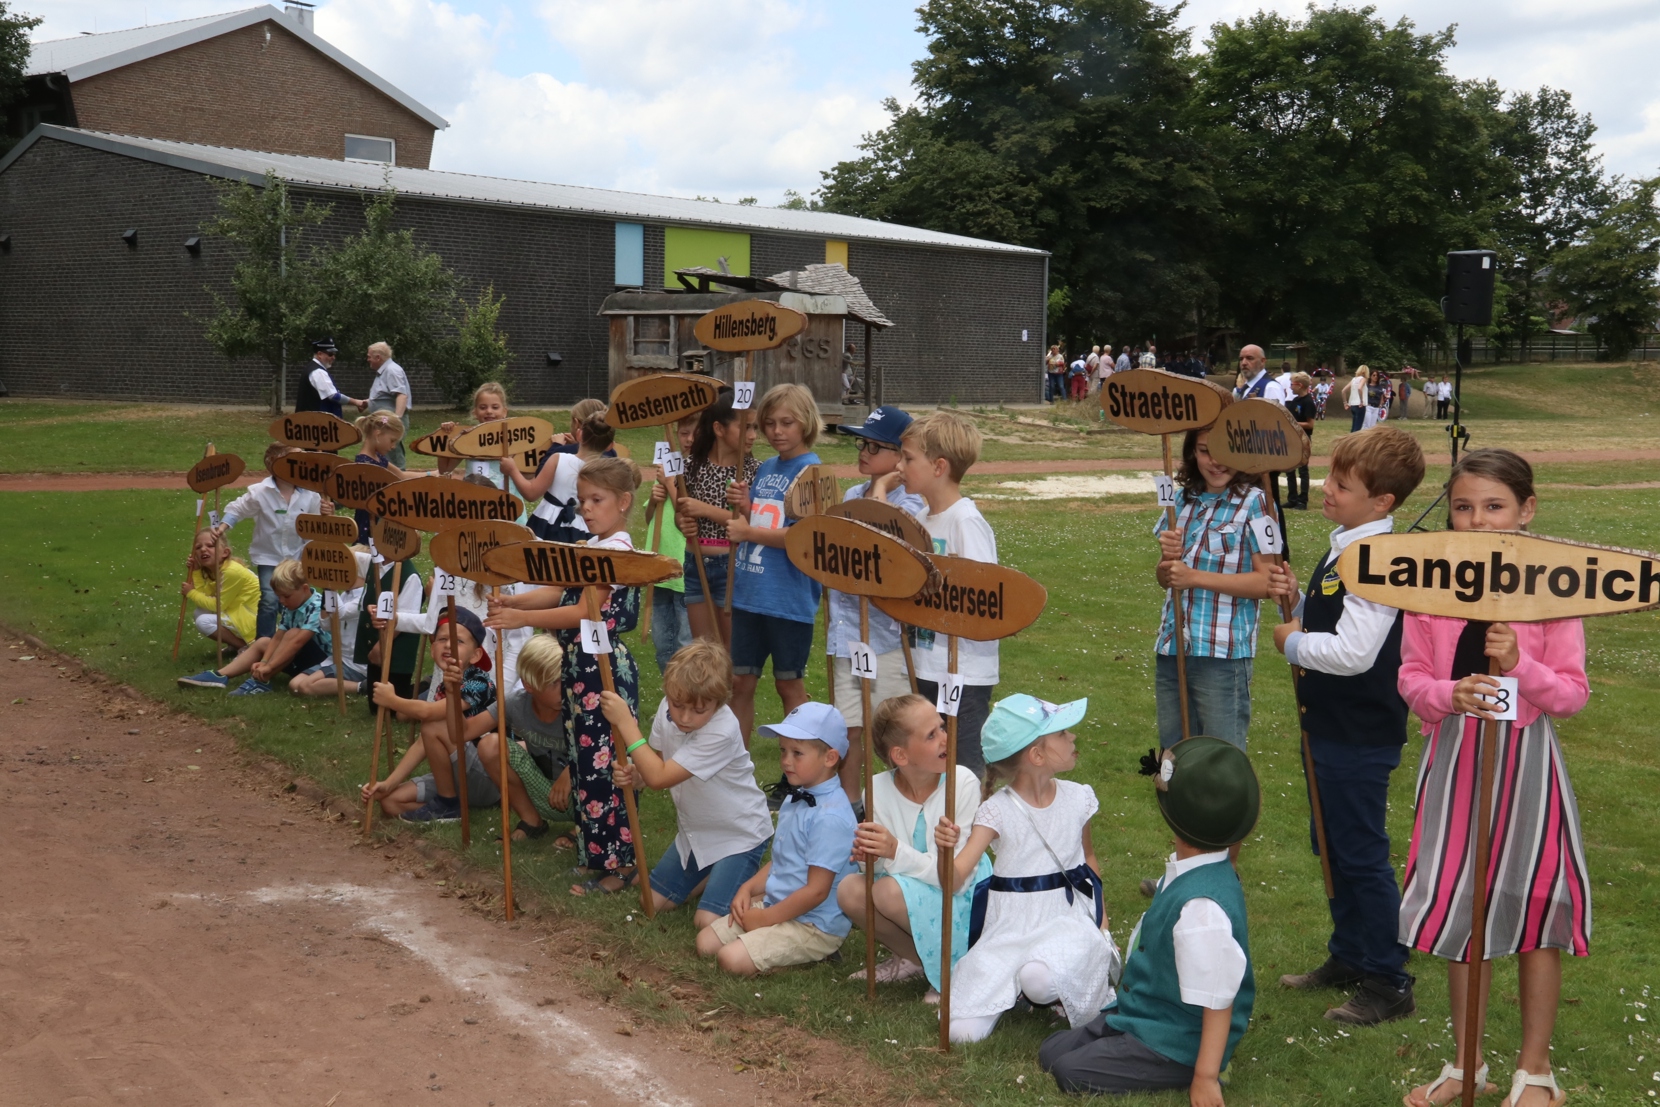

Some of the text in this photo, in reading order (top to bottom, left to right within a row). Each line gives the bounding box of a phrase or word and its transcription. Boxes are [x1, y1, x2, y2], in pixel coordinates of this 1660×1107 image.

[713, 312, 777, 341] Hillensberg
[615, 383, 708, 424] Hastenrath
[737, 388, 752, 404] 20
[1108, 382, 1198, 421] Straeten
[284, 418, 340, 446] Gangelt
[1226, 419, 1288, 456] Schalbruch
[195, 458, 230, 483] Isenbruch
[286, 459, 331, 483] Tüdd
[666, 457, 682, 473] 17
[1160, 483, 1174, 502] 12
[375, 490, 518, 522] Sch-Waldenrath
[298, 519, 353, 537] STANDARTE
[1264, 525, 1275, 546] 9
[306, 547, 349, 563] WANDER-
[522, 547, 617, 583] Millen
[813, 531, 883, 584] Havert
[307, 566, 350, 583] PLAKETTE
[439, 574, 456, 591] 23
[1357, 544, 1660, 603] Langbroich
[914, 576, 1004, 621] sterseel
[592, 629, 600, 646] 4
[854, 651, 873, 673] 11
[942, 683, 960, 705] 14
